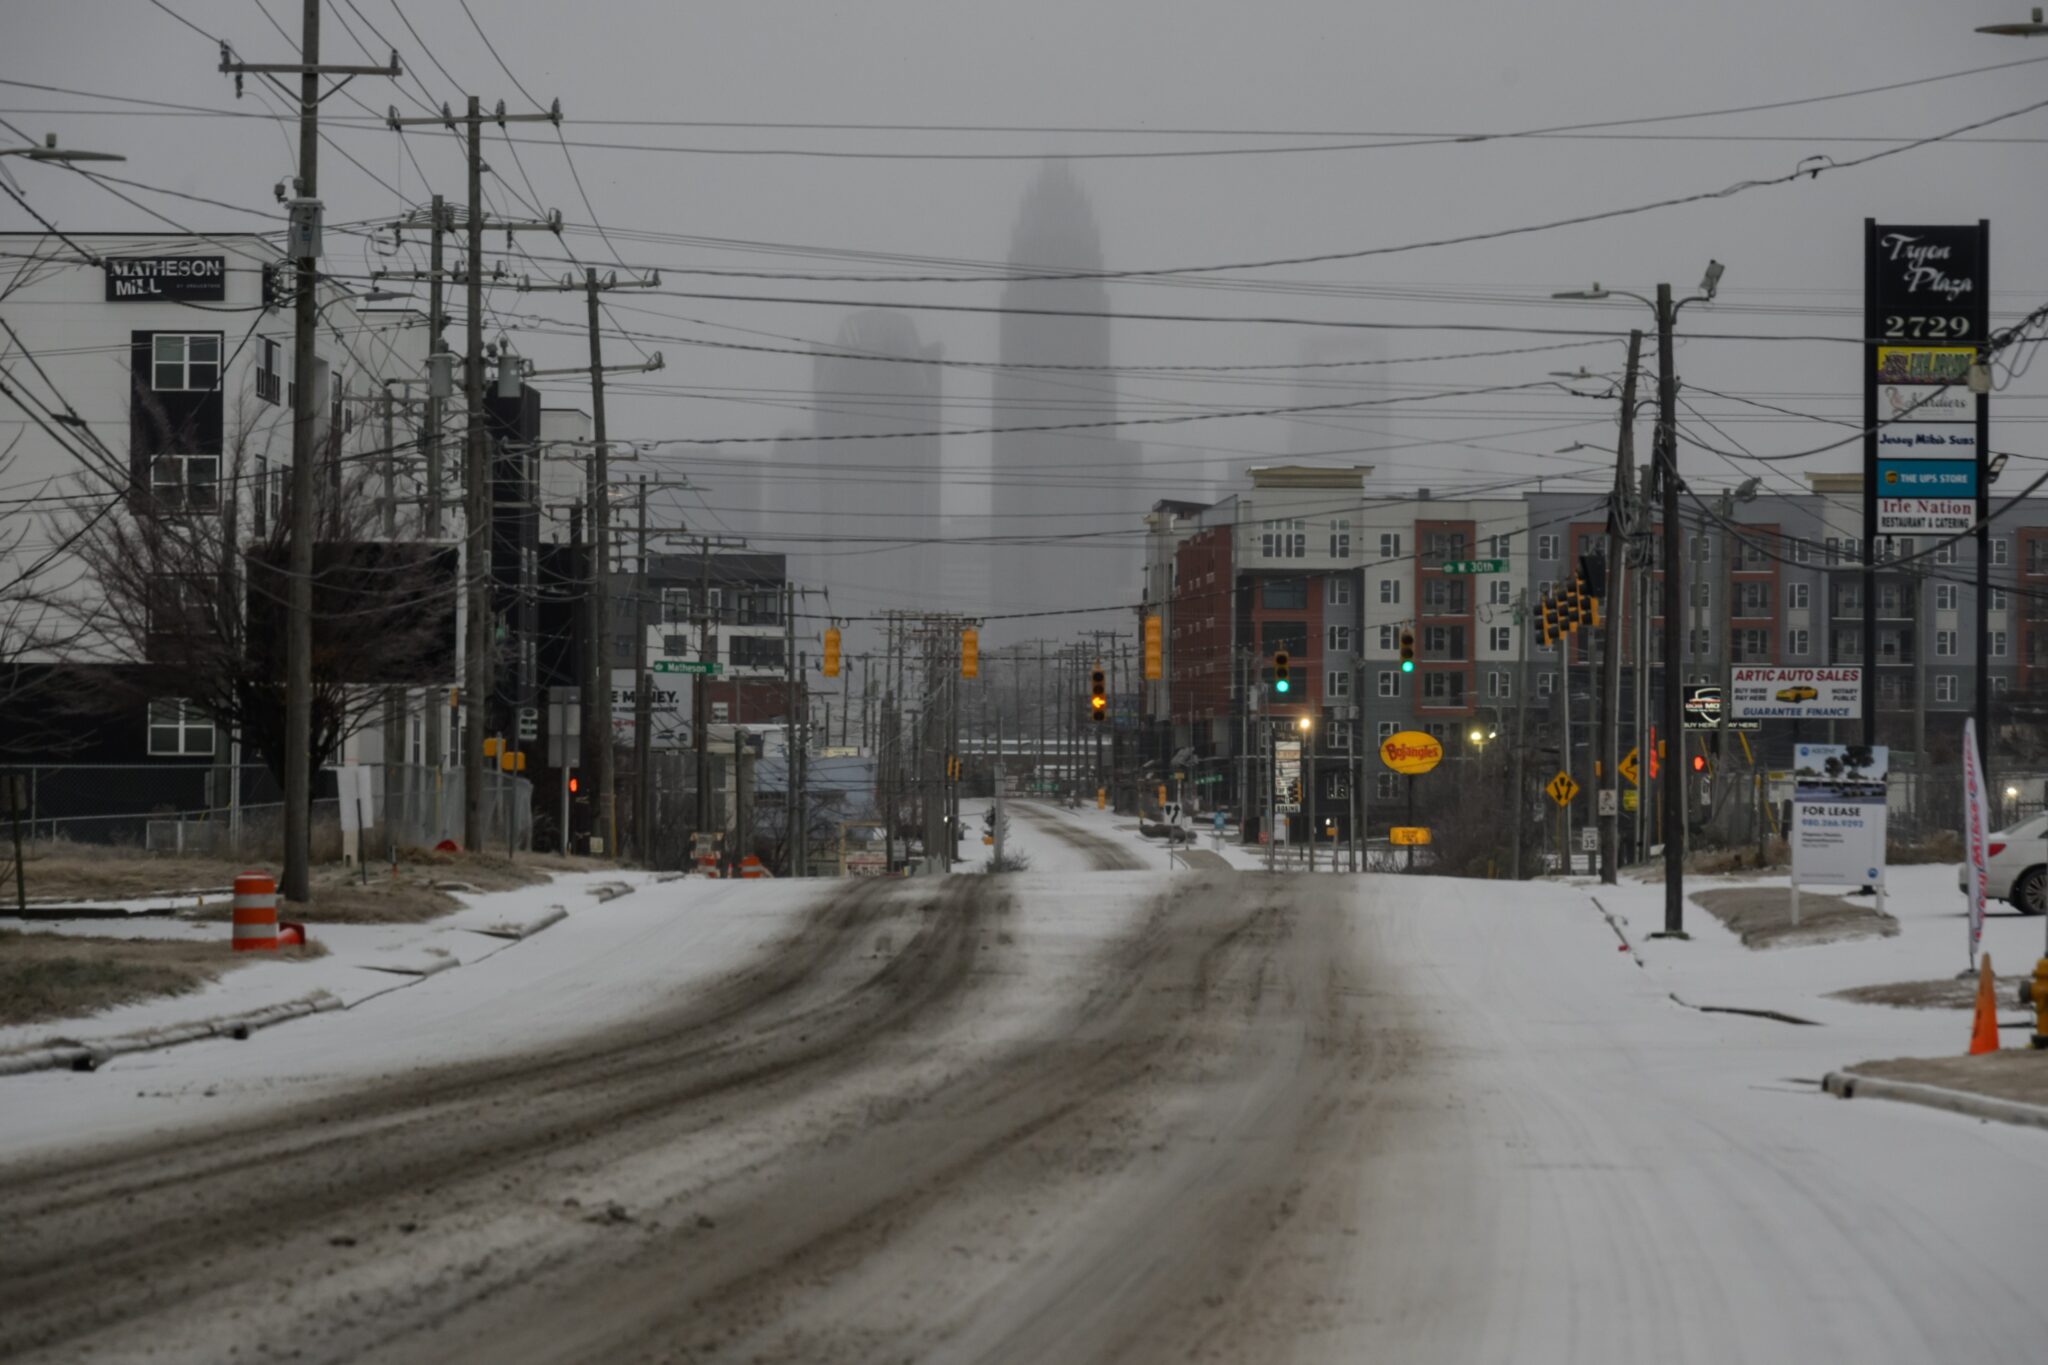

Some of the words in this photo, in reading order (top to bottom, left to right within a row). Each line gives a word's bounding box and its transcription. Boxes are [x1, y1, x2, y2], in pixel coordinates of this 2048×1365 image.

[1881, 232, 1952, 270] Tryon
[109, 260, 220, 277] MATHESON
[1903, 266, 1973, 302] Plaza
[1885, 315, 1970, 338] 2729
[1879, 434, 1914, 447] Jersey
[1900, 473, 1917, 483] THE
[1919, 473, 1938, 483] UPS
[1939, 473, 1968, 484] STORE
[1883, 499, 1912, 513] Irie
[1916, 500, 1971, 515] Nation
[1881, 516, 1926, 528] RESTAURANT
[1927, 518, 1933, 528] &
[1935, 517, 1969, 529] CATERING
[1470, 561, 1494, 573] 30th
[668, 662, 706, 672] Matheson
[1735, 670, 1775, 681] ARTIC
[1775, 670, 1815, 681] AUTO
[1816, 670, 1859, 682] SALES
[1743, 707, 1802, 716] GUARANTEE
[1806, 707, 1850, 717] FINANCE
[1802, 806, 1825, 817] FOR
[1828, 807, 1861, 818] LEASE
[1583, 839, 1595, 849] 35
